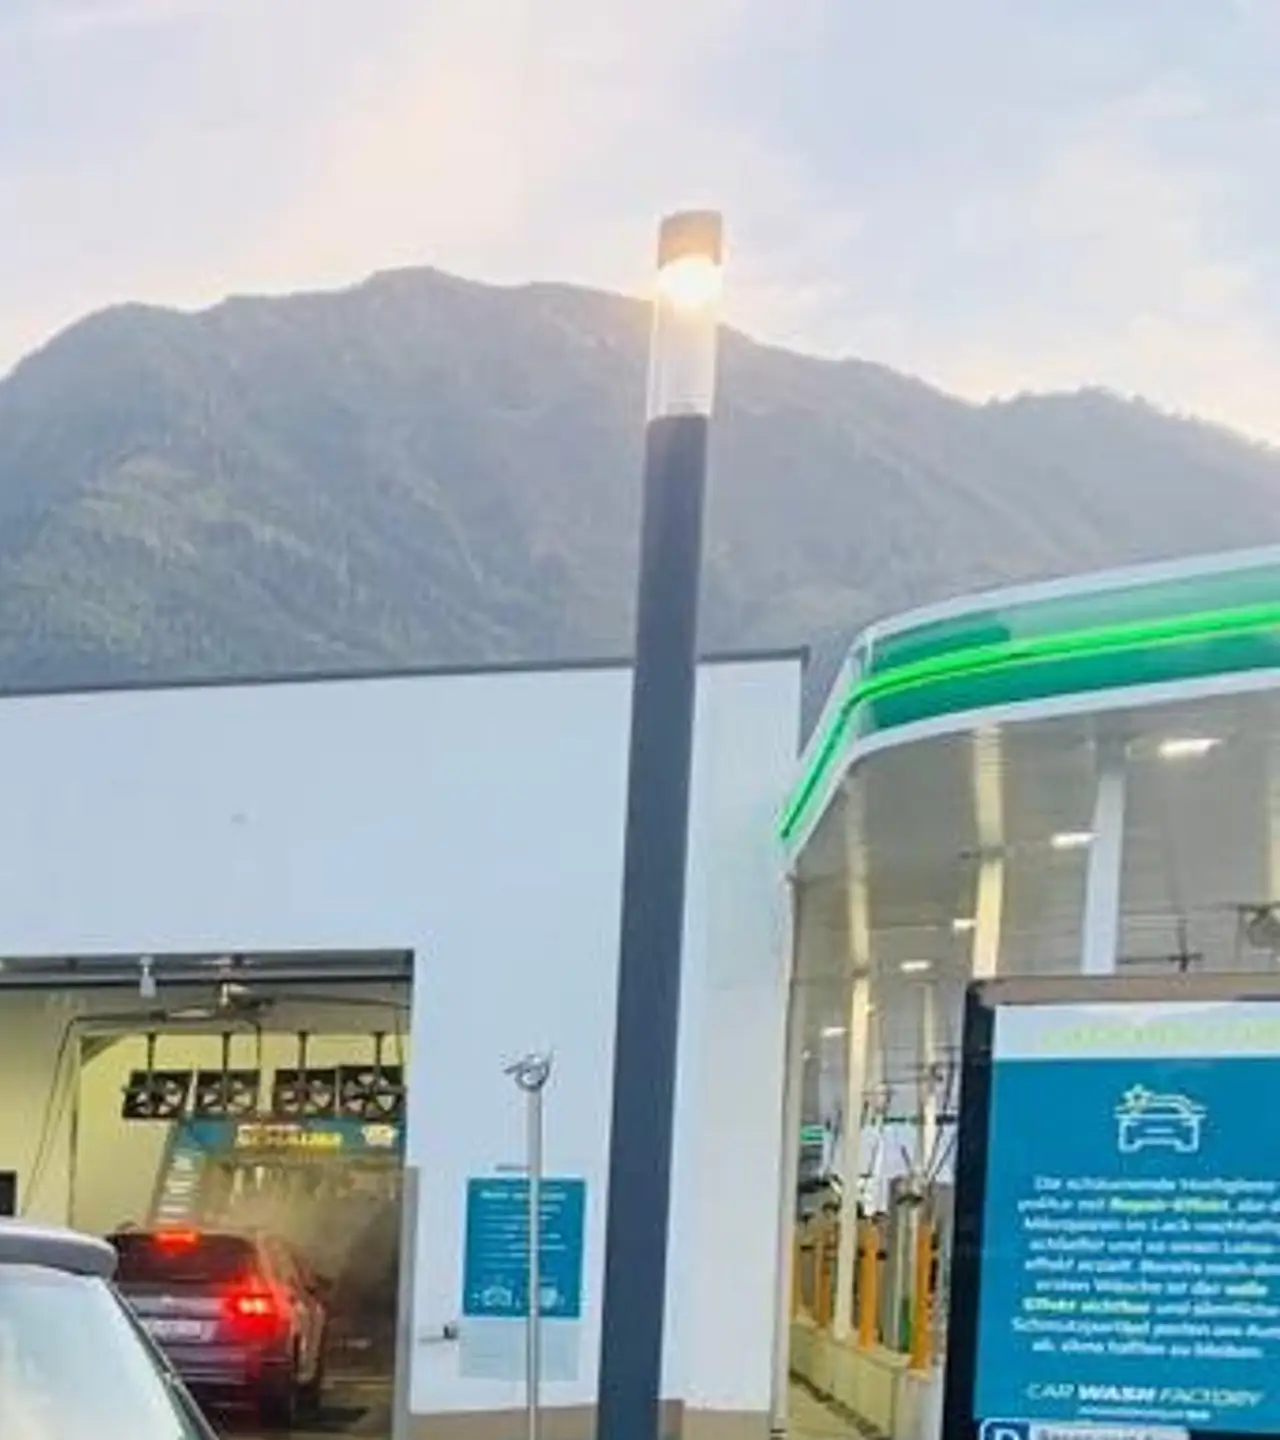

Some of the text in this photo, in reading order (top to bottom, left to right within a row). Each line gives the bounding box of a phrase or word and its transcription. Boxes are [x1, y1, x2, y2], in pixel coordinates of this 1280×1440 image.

[1027, 1382, 1267, 1407] CAR WASH FACTORY
